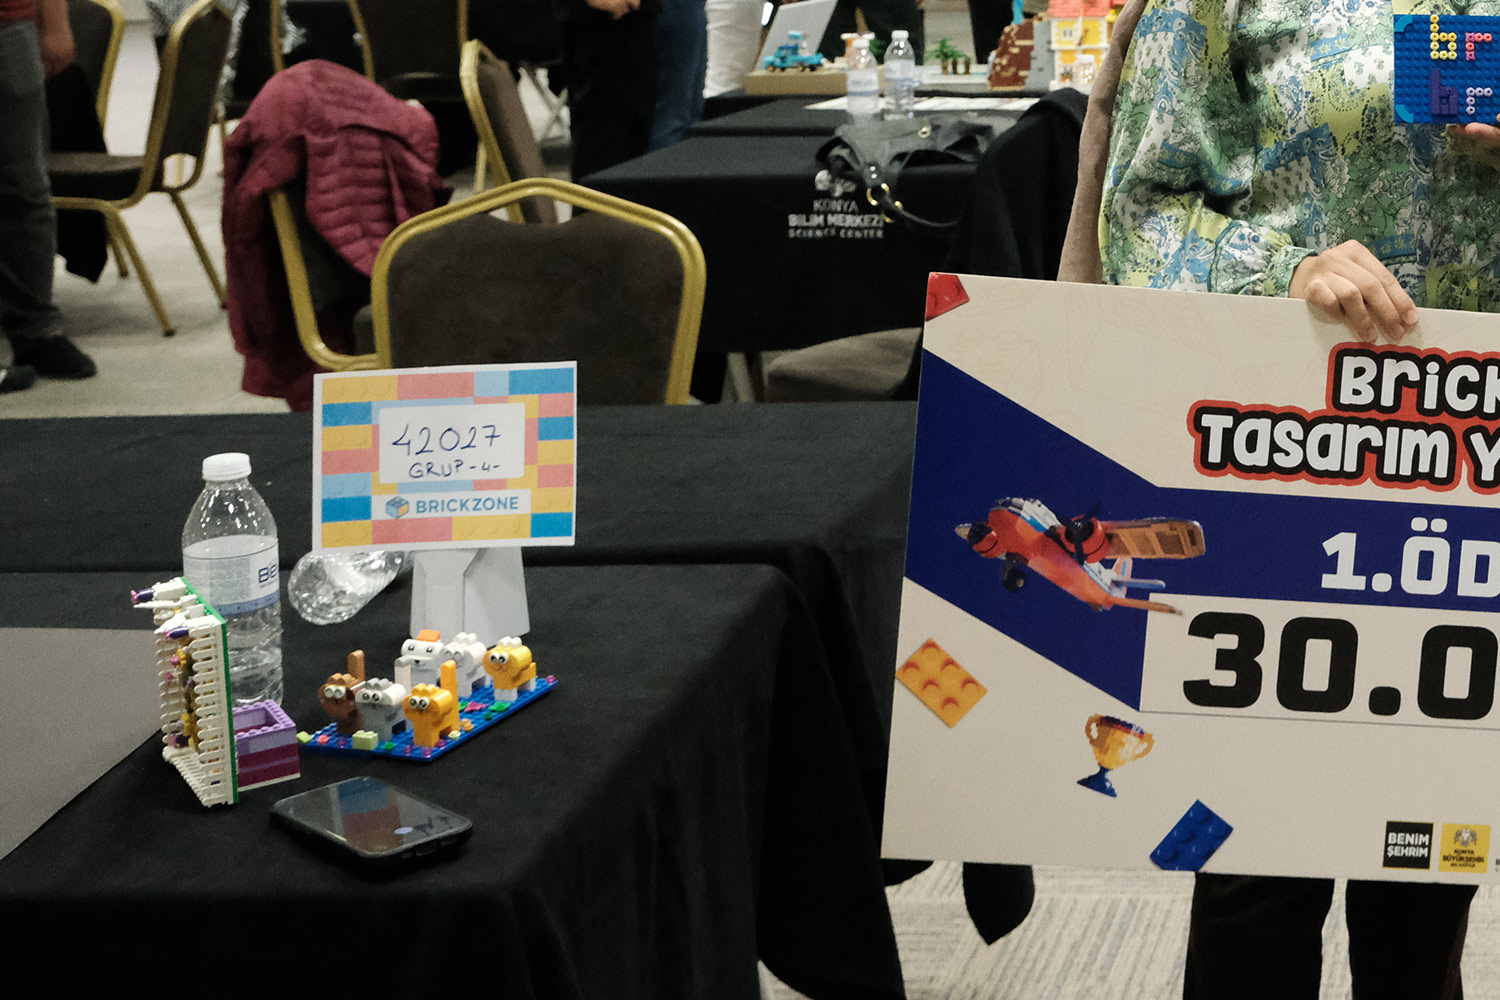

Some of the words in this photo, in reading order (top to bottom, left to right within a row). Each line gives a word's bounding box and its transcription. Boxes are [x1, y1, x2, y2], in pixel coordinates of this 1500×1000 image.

[812, 199, 859, 213] KONYA
[839, 228, 885, 239] CENTER
[391, 423, 502, 457] 42027
[408, 458, 465, 480] GRUP
[415, 495, 520, 514] BRICKZONE
[1387, 832, 1431, 847] BENİM
